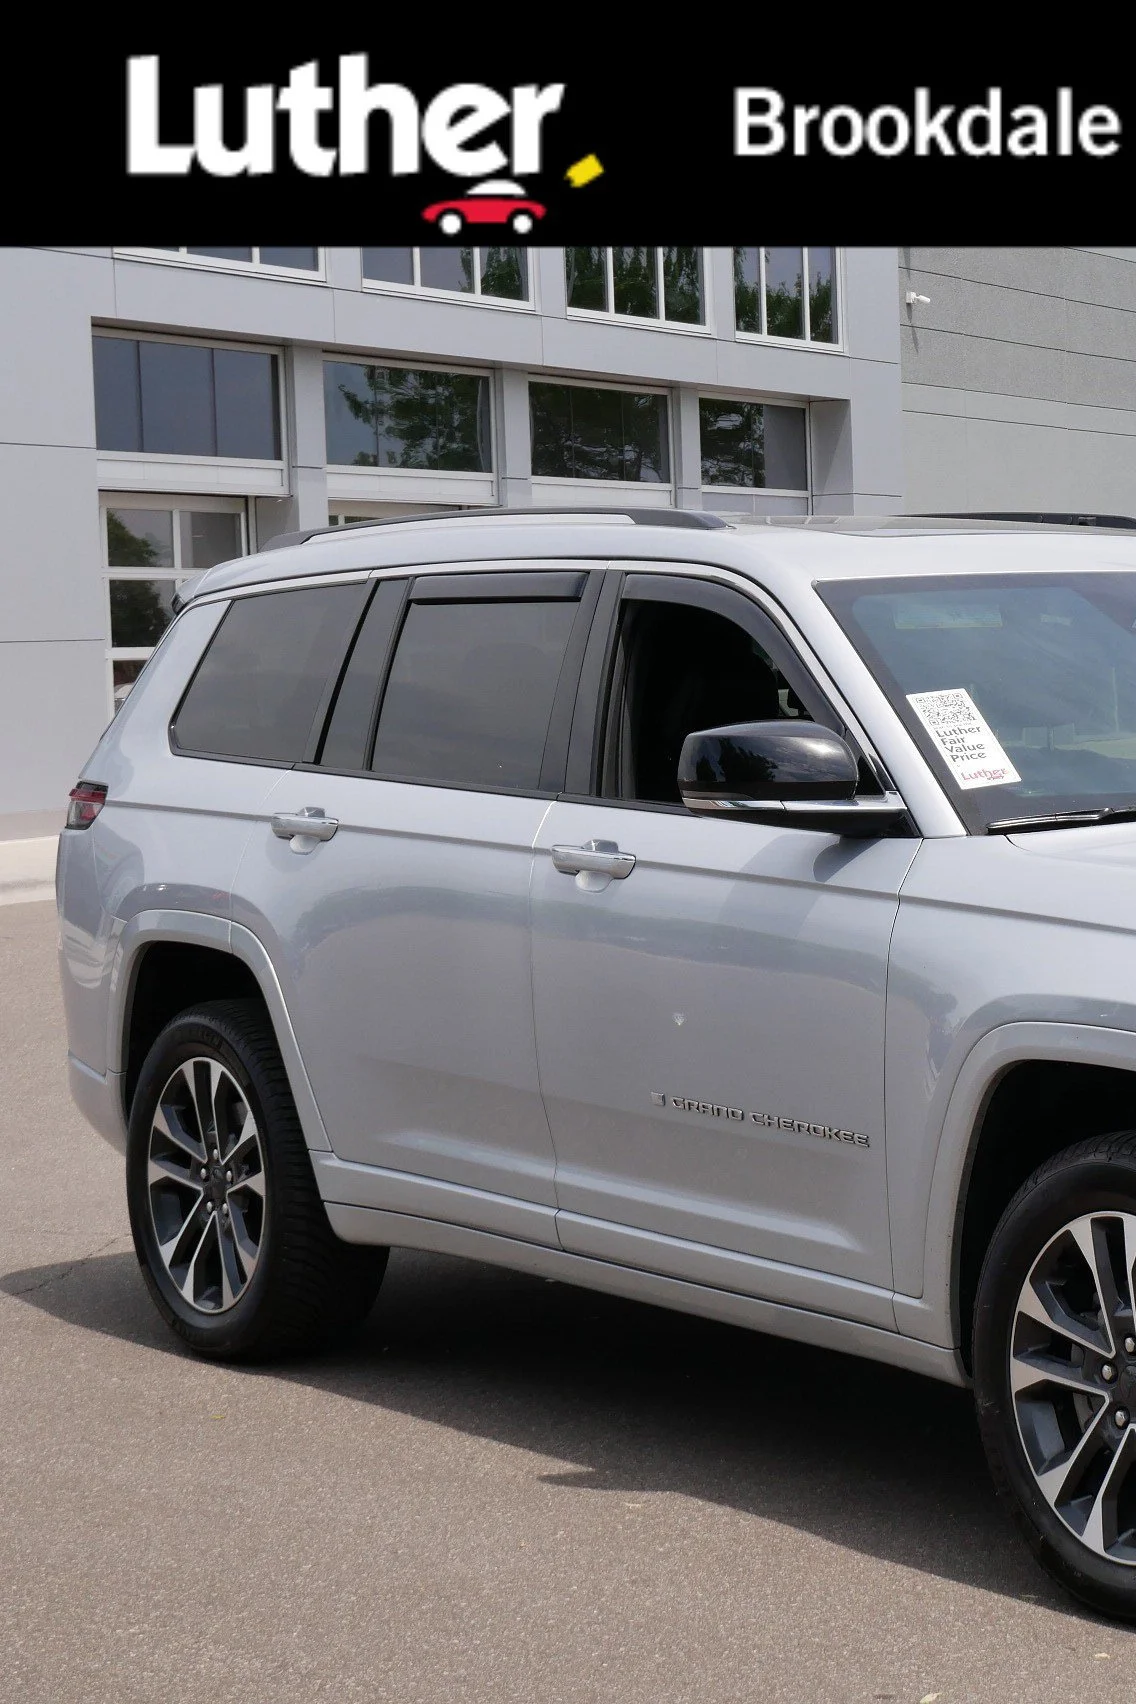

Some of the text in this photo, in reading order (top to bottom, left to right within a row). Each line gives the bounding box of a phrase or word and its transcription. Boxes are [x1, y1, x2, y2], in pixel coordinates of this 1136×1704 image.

[935, 726, 982, 738] Luther
[940, 736, 965, 746] Fair
[945, 743, 985, 753] Value
[950, 751, 987, 763] Price
[960, 767, 1009, 780] Luther
[671, 1096, 871, 1148] GRAND CHEROKEE
